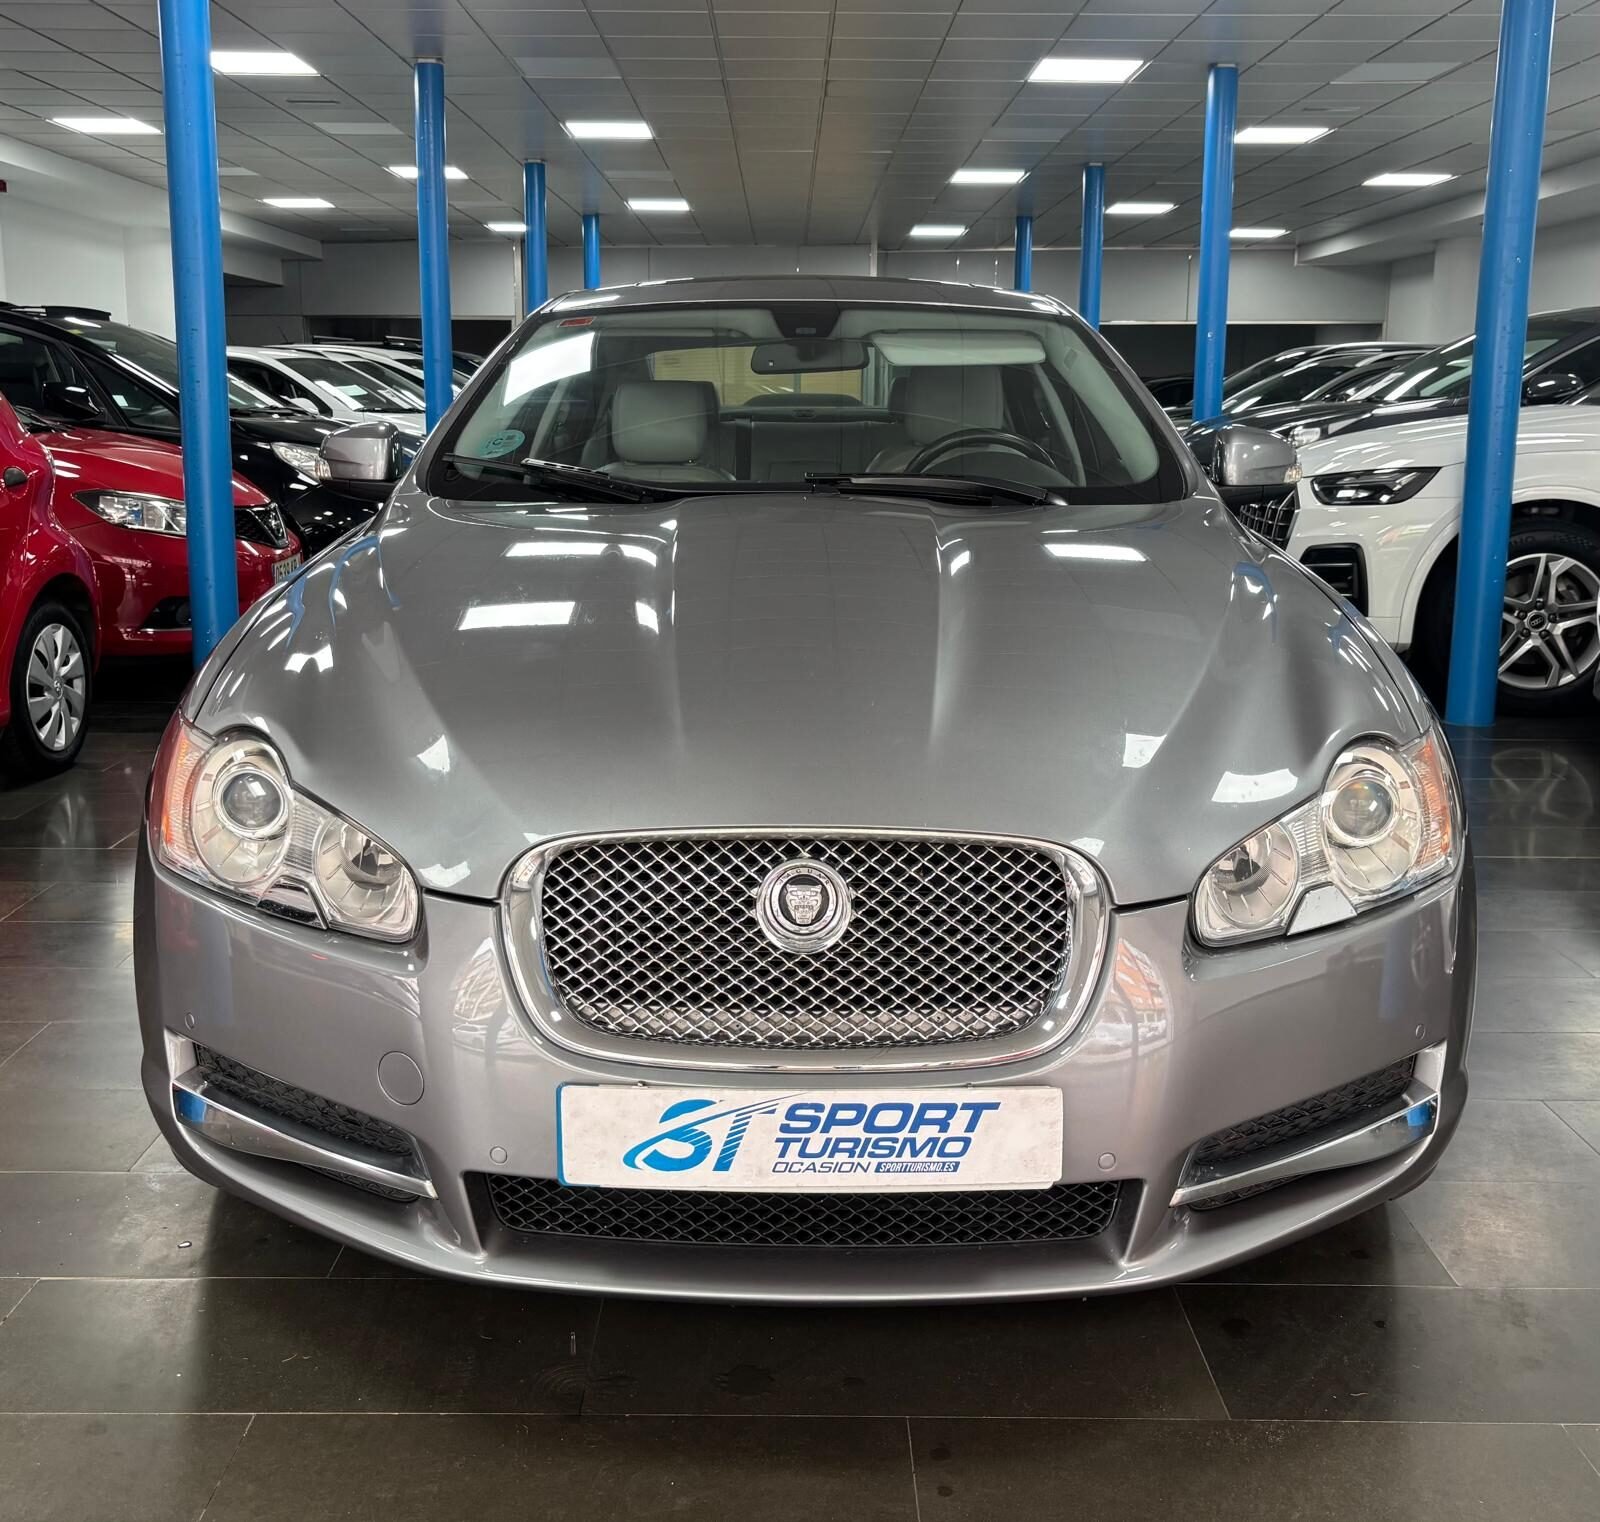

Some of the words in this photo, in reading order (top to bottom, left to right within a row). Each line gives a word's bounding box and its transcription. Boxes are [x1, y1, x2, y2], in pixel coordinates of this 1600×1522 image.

[779, 1102, 1001, 1134] SPORT
[774, 1136, 972, 1159] TURISMO
[772, 1161, 871, 1173] OCASION
[878, 1161, 957, 1173] SPORTTURISMO.ES
